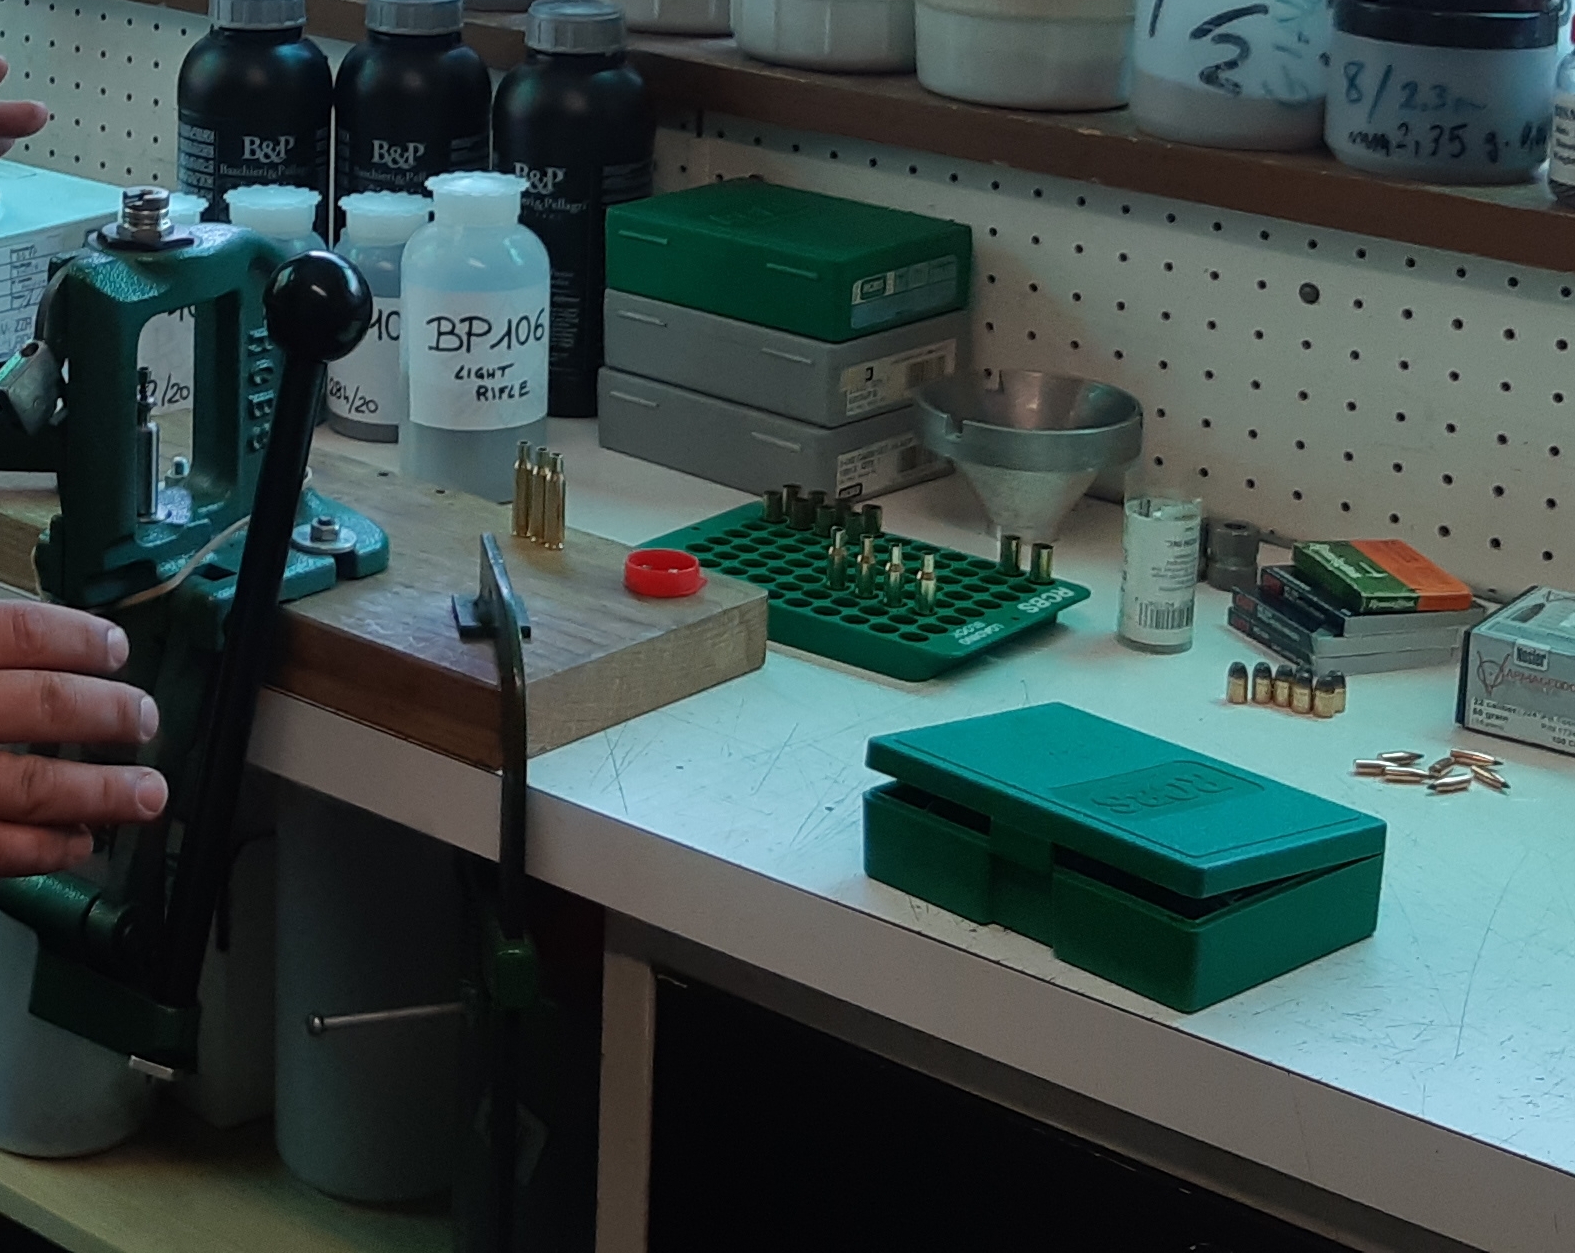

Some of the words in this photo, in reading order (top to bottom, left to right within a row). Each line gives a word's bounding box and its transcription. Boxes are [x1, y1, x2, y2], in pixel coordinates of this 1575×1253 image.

[242, 135, 295, 163] B&P
[371, 139, 425, 169] B&P
[454, 363, 514, 380] LIGHT
[476, 380, 530, 402] RIFLE
[1017, 587, 1075, 614] RCBS
